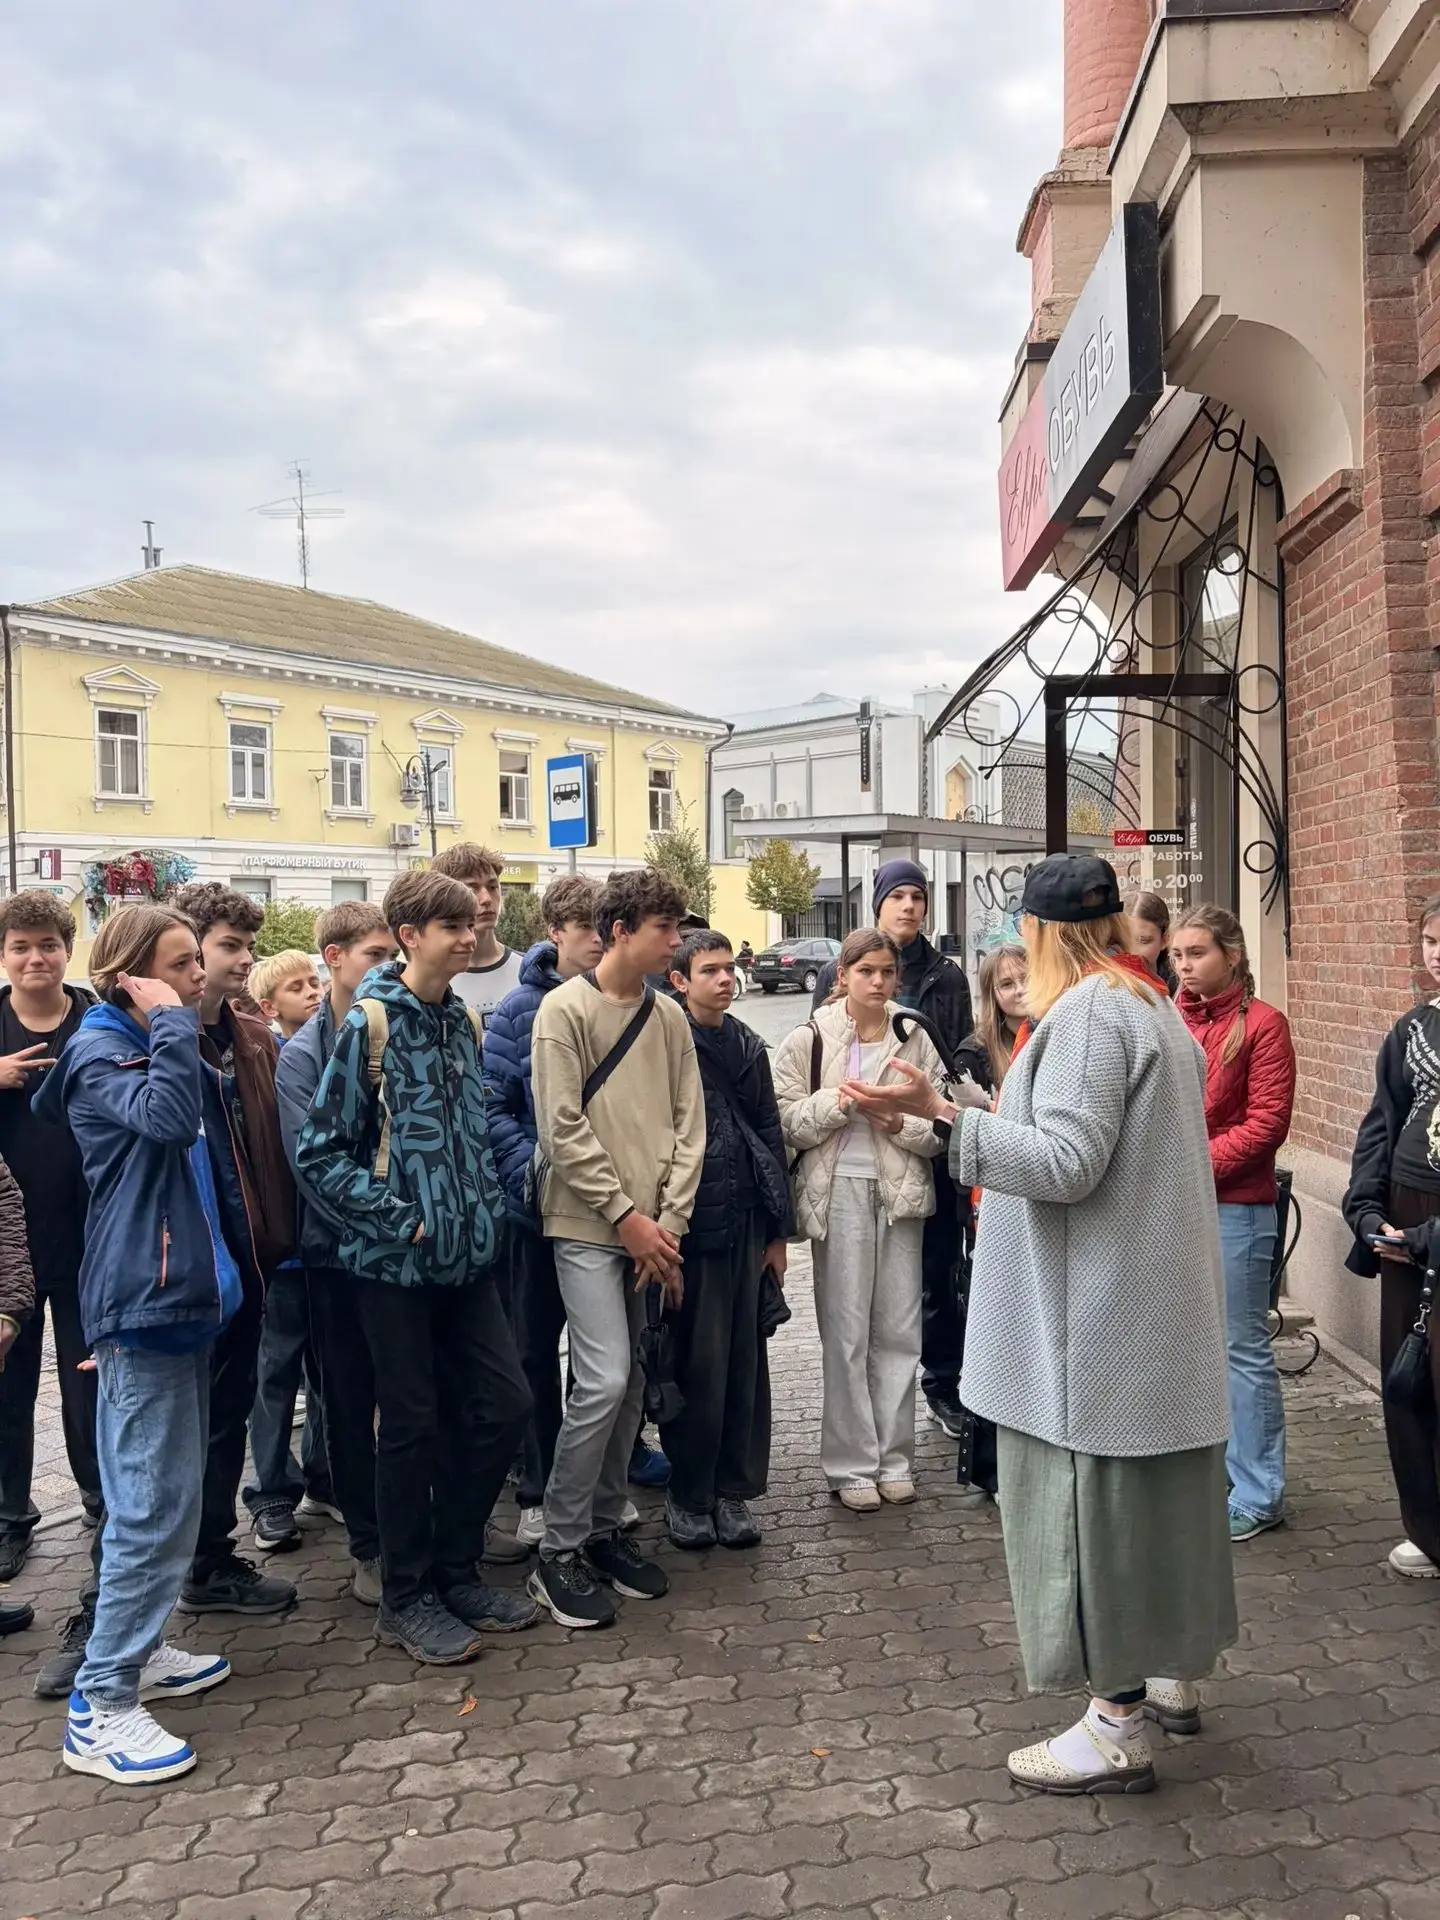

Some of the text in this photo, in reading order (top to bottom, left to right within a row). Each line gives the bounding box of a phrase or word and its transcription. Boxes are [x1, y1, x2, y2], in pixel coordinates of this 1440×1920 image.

[1049, 315, 1115, 474] ОБУВЬ
[1148, 833, 1184, 843] ОБУВЬ
[245, 855, 367, 869] ПАРФЮМЕРНЫЙ БУТИК
[1148, 851, 1203, 861] РАБОТЫ
